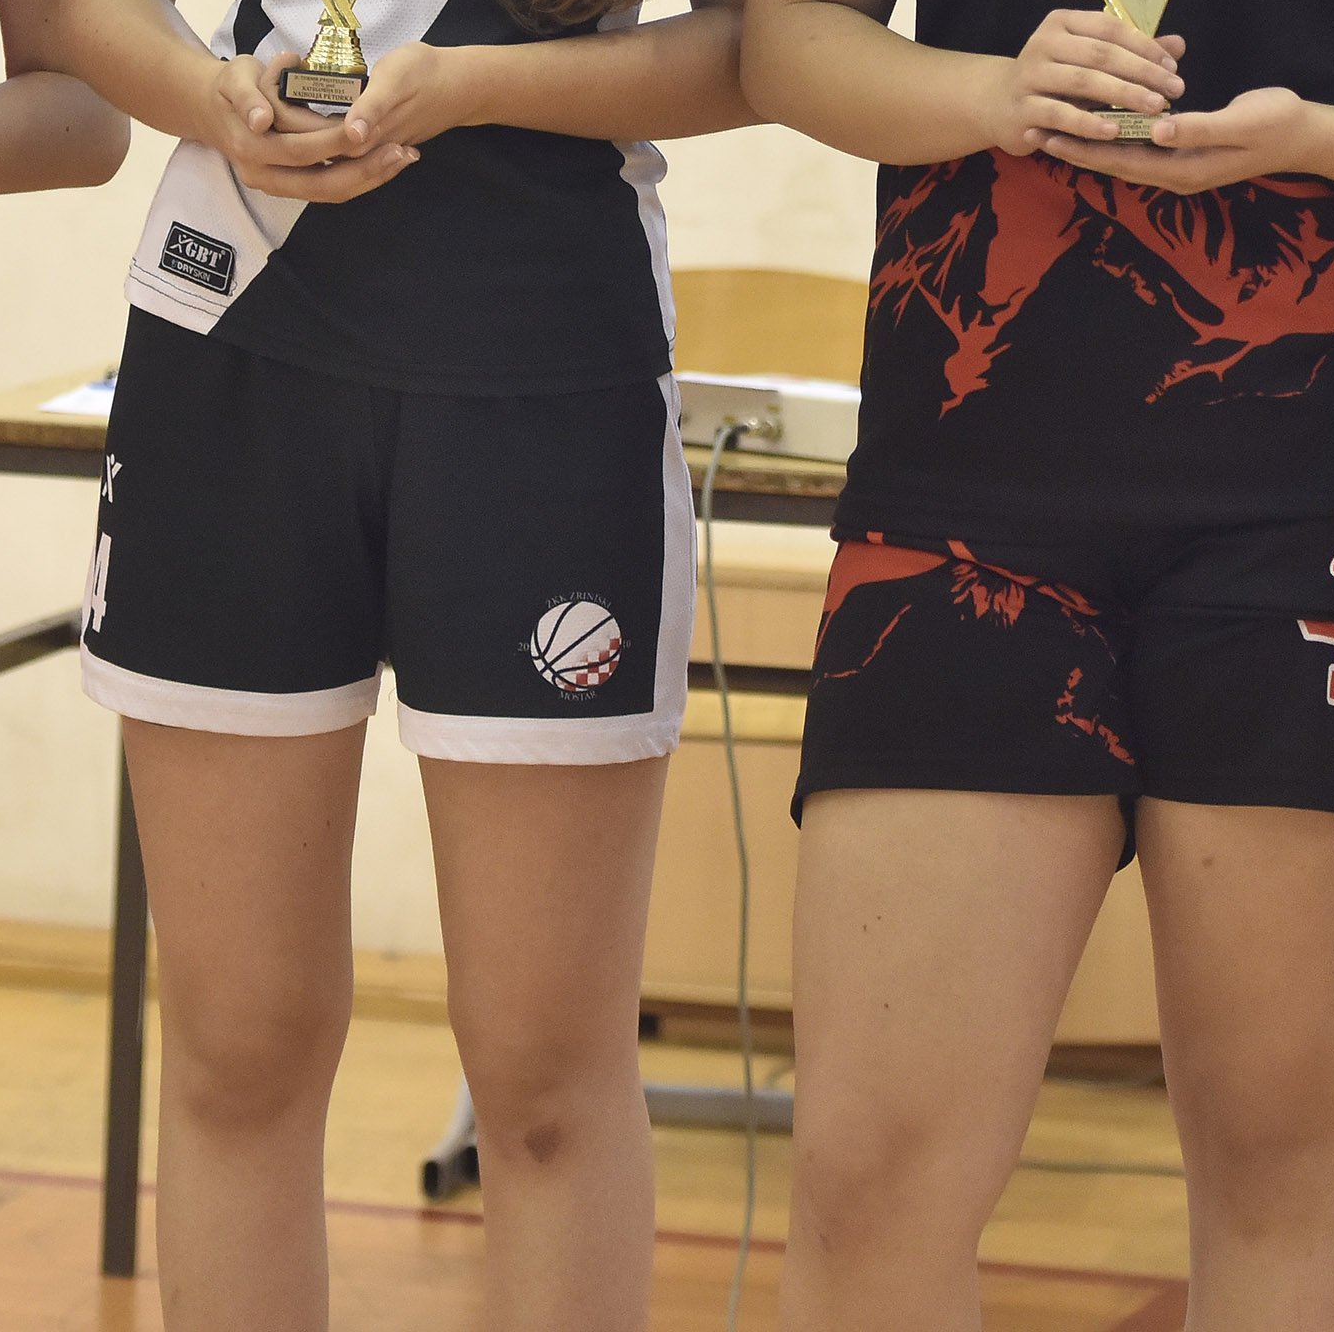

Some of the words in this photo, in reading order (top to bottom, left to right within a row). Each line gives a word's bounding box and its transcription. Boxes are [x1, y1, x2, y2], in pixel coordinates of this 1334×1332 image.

[185, 241, 223, 268] GBT
[176, 262, 211, 283] DRYSKIN
[90, 531, 113, 634] 4
